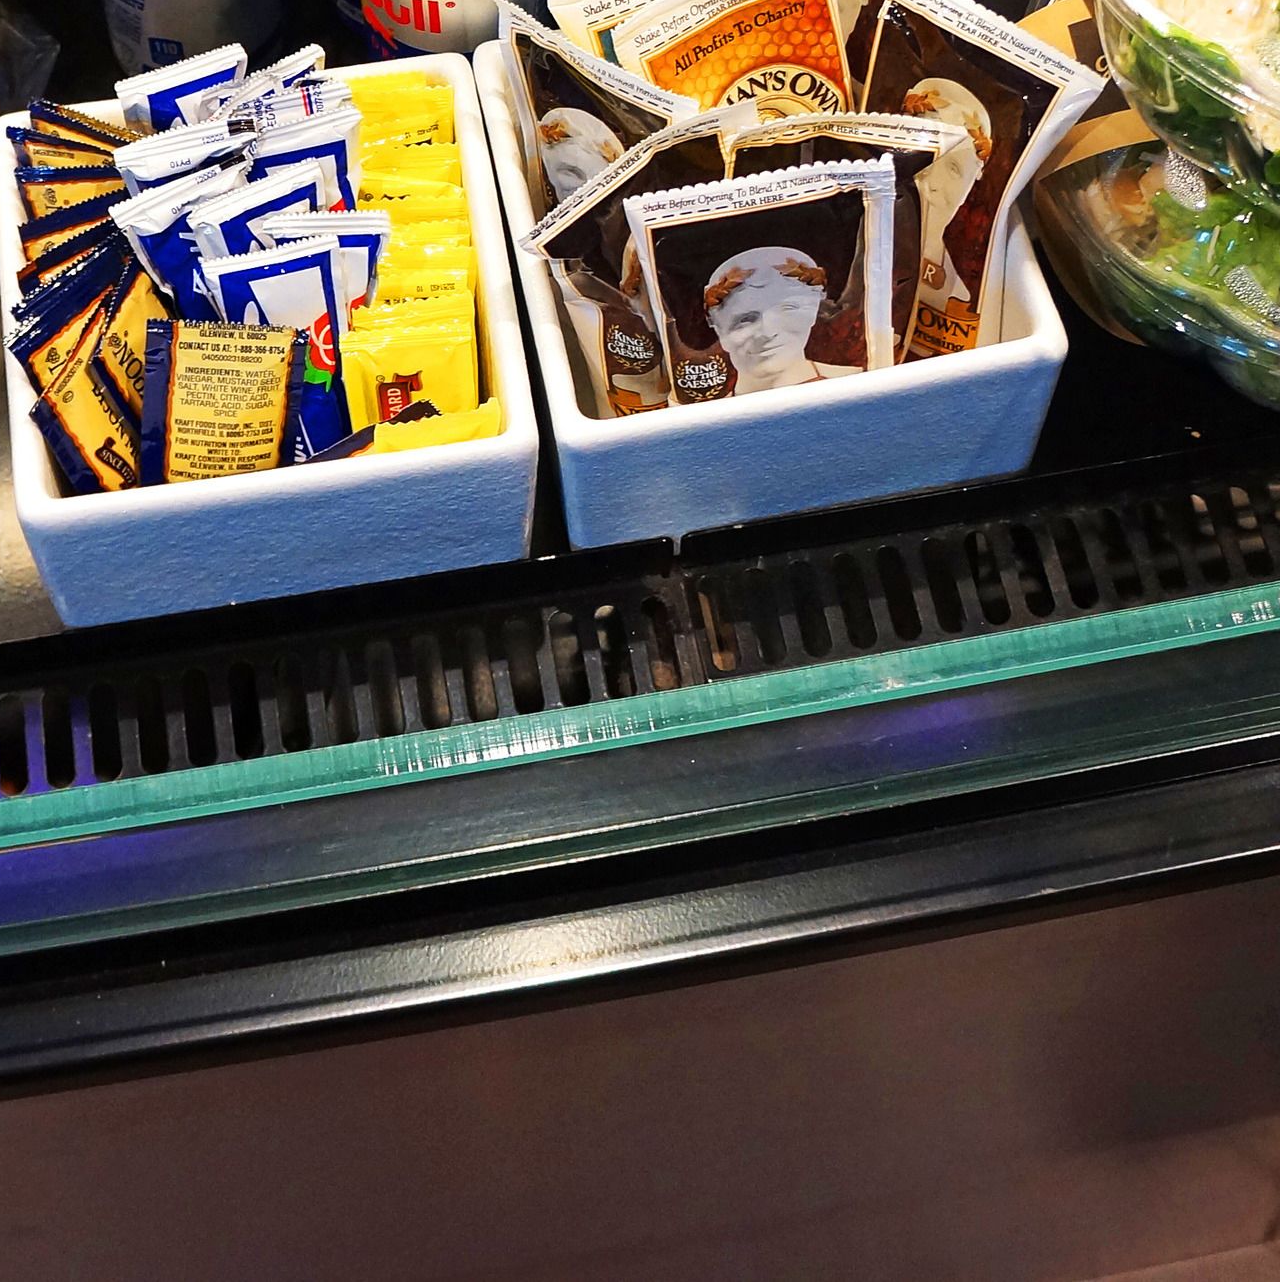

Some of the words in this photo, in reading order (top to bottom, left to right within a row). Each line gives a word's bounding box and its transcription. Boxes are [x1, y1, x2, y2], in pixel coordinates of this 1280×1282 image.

[583, 1, 612, 19] Shake
[706, 4, 729, 19] TEAR
[635, 30, 661, 49] Shake
[662, 13, 690, 37] Before
[673, 52, 693, 75] All
[692, 29, 735, 63] Profits
[735, 19, 754, 36] To
[753, 0, 807, 28] Charity
[956, 21, 977, 36] TEAR
[977, 32, 999, 47] HERE
[974, 17, 997, 35] Blend
[996, 29, 1009, 42] All
[1007, 35, 1038, 57] Natural
[155, 42, 178, 55] 110
[812, 125, 834, 133] TEAR
[837, 126, 860, 136] HERE
[642, 202, 667, 214] Shake
[669, 198, 696, 210] Before
[697, 191, 734, 207] Opening
[736, 189, 747, 198] To
[749, 185, 773, 197] Blend
[775, 181, 788, 192] All
[789, 174, 822, 188] Natural
[732, 199, 757, 209] TEAR
[759, 194, 784, 204] HERE
[200, 329, 237, 340] GLENVIEW,
[247, 332, 268, 341] 60025
[614, 331, 645, 347] KING
[179, 342, 210, 352] CONTACT
[211, 343, 221, 351] US
[222, 344, 232, 353] AT:
[607, 343, 654, 359] CAESARS
[627, 344, 645, 354] THE
[185, 367, 243, 377] INGREDIENTS:
[245, 370, 276, 378] WATER,
[684, 361, 718, 375] KING
[177, 373, 216, 383] VINEGAR,
[217, 377, 258, 386] MUSTARD
[678, 374, 727, 389] CAESARS
[686, 372, 698, 381] OF
[700, 369, 719, 381] THE
[178, 383, 200, 391] SALT,
[202, 384, 228, 393] WHITE
[231, 385, 255, 394] WINE,
[257, 384, 280, 393] FRUIT
[186, 391, 217, 400] PECTIN,
[220, 393, 248, 401] CITRIC
[180, 398, 219, 409] TARTARIC
[221, 402, 243, 410] ACID,
[214, 409, 238, 417] SPICE
